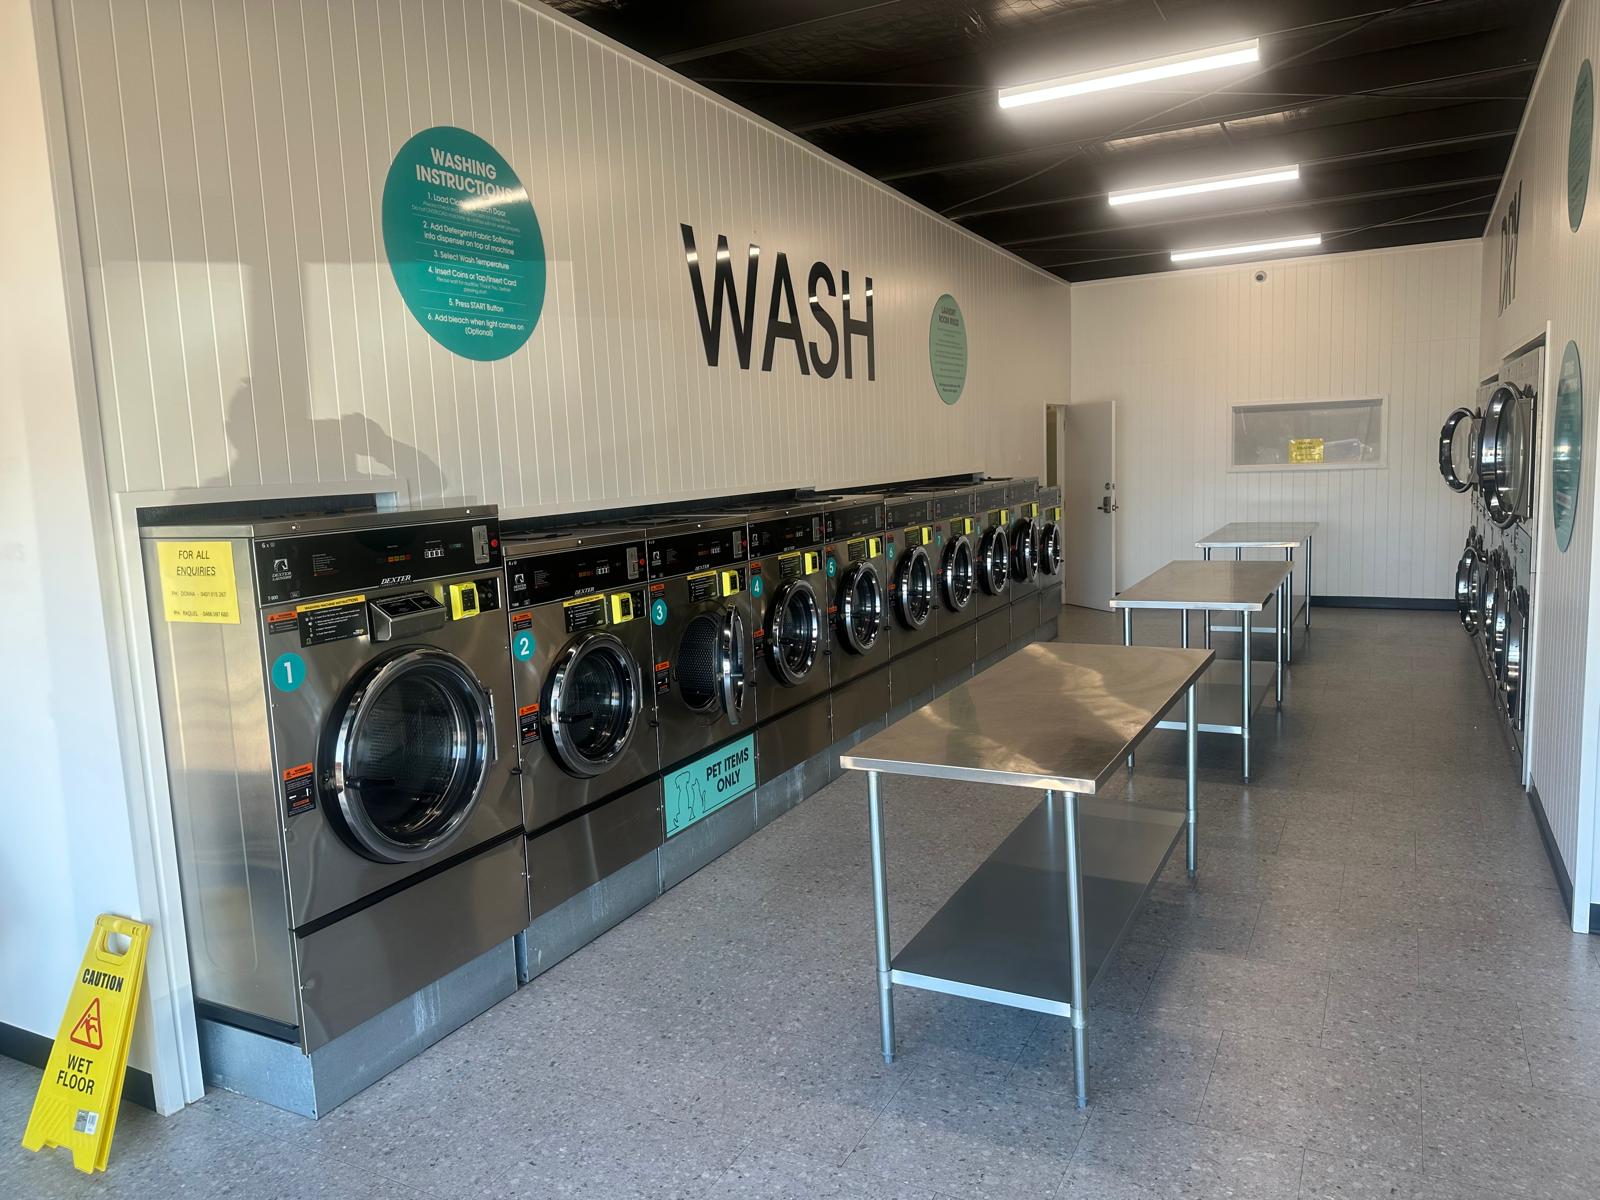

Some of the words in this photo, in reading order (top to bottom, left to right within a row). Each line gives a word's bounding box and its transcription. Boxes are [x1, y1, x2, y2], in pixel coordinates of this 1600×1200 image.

[430, 147, 497, 180] WASHING
[416, 164, 513, 201] INSTRUCTIONS
[433, 194, 449, 204] Load
[493, 208, 506, 217] Door
[422, 220, 429, 228] 2.
[430, 222, 444, 232] Add
[444, 225, 491, 242] Detergent/Fabric
[492, 235, 514, 246] Softener
[436, 234, 465, 246] dispenser
[474, 241, 484, 250] top
[484, 243, 491, 251] of
[491, 245, 515, 256] machine
[440, 250, 459, 261] Select
[459, 254, 475, 264] Wash
[475, 257, 510, 270] Temperature
[428, 265, 433, 274] 4.
[434, 266, 452, 276] Insert
[452, 269, 469, 279] Coins
[475, 273, 503, 285] Tap/Insert
[503, 278, 517, 287] Card
[448, 297, 454, 306] 5.
[455, 299, 470, 309] Press
[470, 302, 486, 311] START
[486, 303, 504, 313] Button
[680, 222, 876, 382] WASH
[427, 312, 433, 320] 6.
[434, 313, 447, 322] Add
[447, 315, 470, 324] bleach
[470, 318, 486, 327] when
[486, 319, 498, 329] light
[498, 321, 517, 330] comes
[464, 326, 494, 338] (Optional)
[179, 550, 194, 560] FOR
[196, 550, 211, 560] ALL
[176, 566, 216, 577] ENQUIRIES
[829, 563, 834, 573] 5
[380, 574, 412, 585] DEXTER
[754, 582, 760, 593] 4
[656, 604, 664, 620] 3
[520, 637, 530, 656] 2
[284, 661, 293, 684] 1
[706, 761, 723, 781] PET
[723, 747, 749, 772] ITEMS
[716, 769, 741, 793] ONLY
[81, 968, 124, 993] CAUTION
[66, 1054, 94, 1076] WET
[56, 1070, 95, 1096] FLOOR
